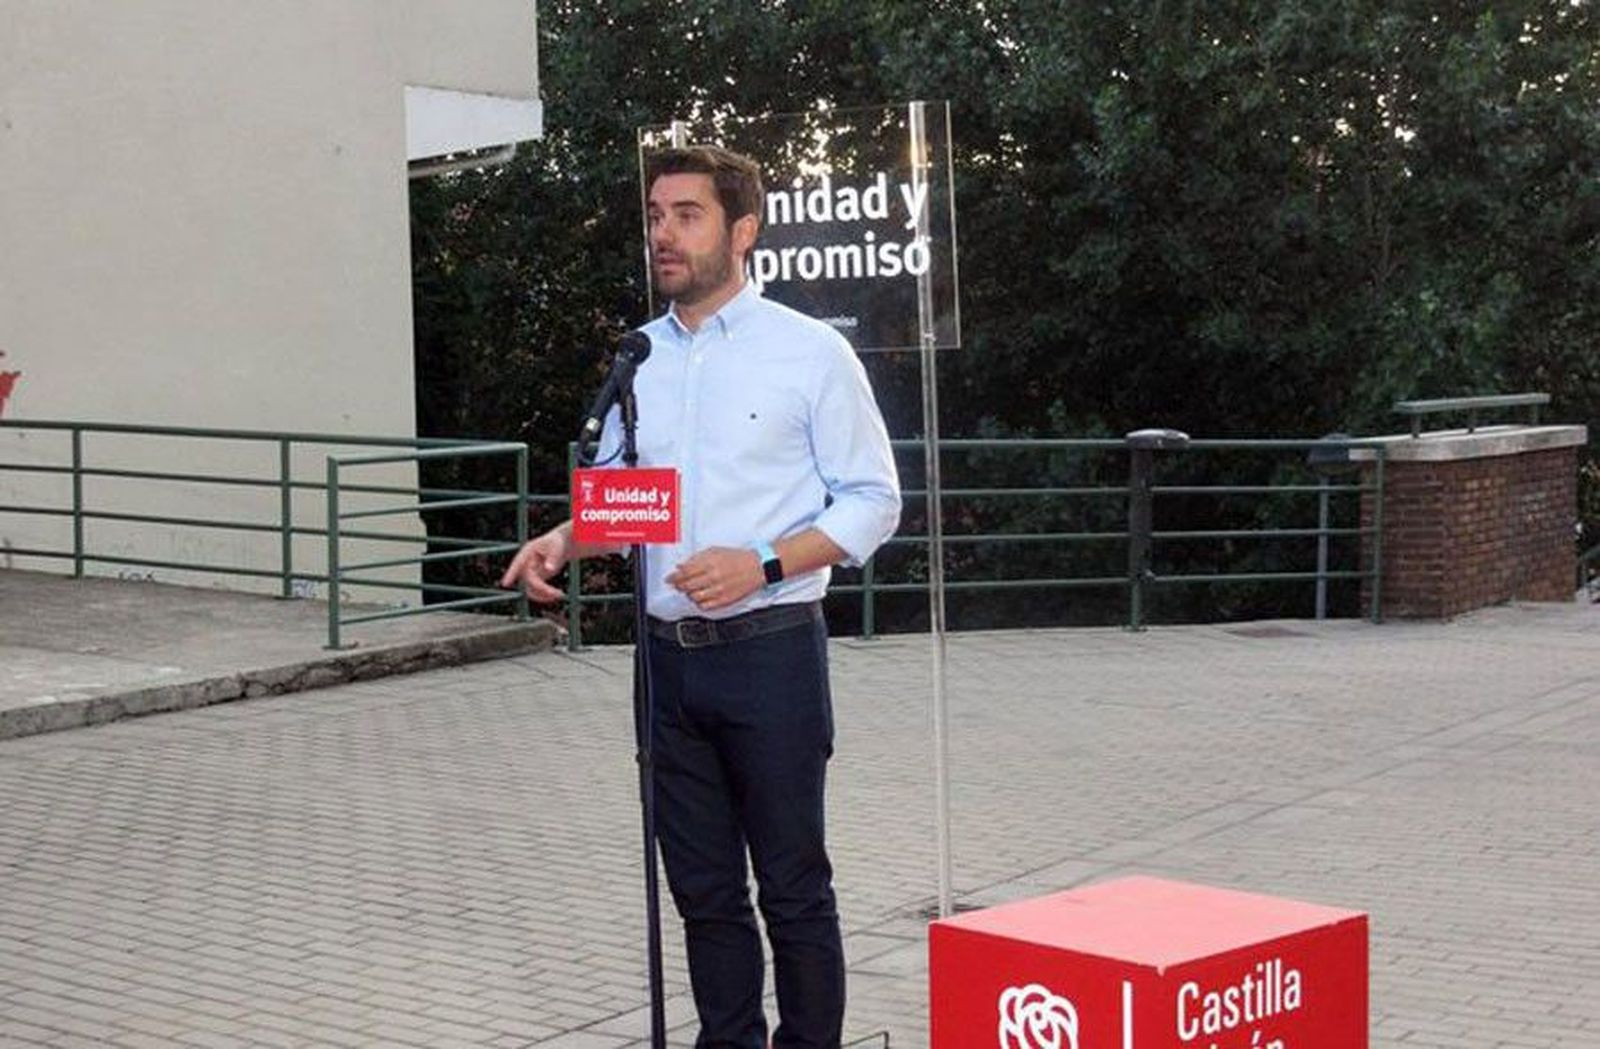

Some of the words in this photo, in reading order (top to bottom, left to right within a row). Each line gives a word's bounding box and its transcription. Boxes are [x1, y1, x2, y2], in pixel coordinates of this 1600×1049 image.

[765, 171, 888, 225] nidad
[900, 182, 928, 230] y
[746, 230, 932, 294] promiso
[580, 505, 671, 525] compromiso
[603, 486, 658, 503] Unidad
[660, 490, 671, 508] y
[1176, 957, 1302, 1041] Castilla
